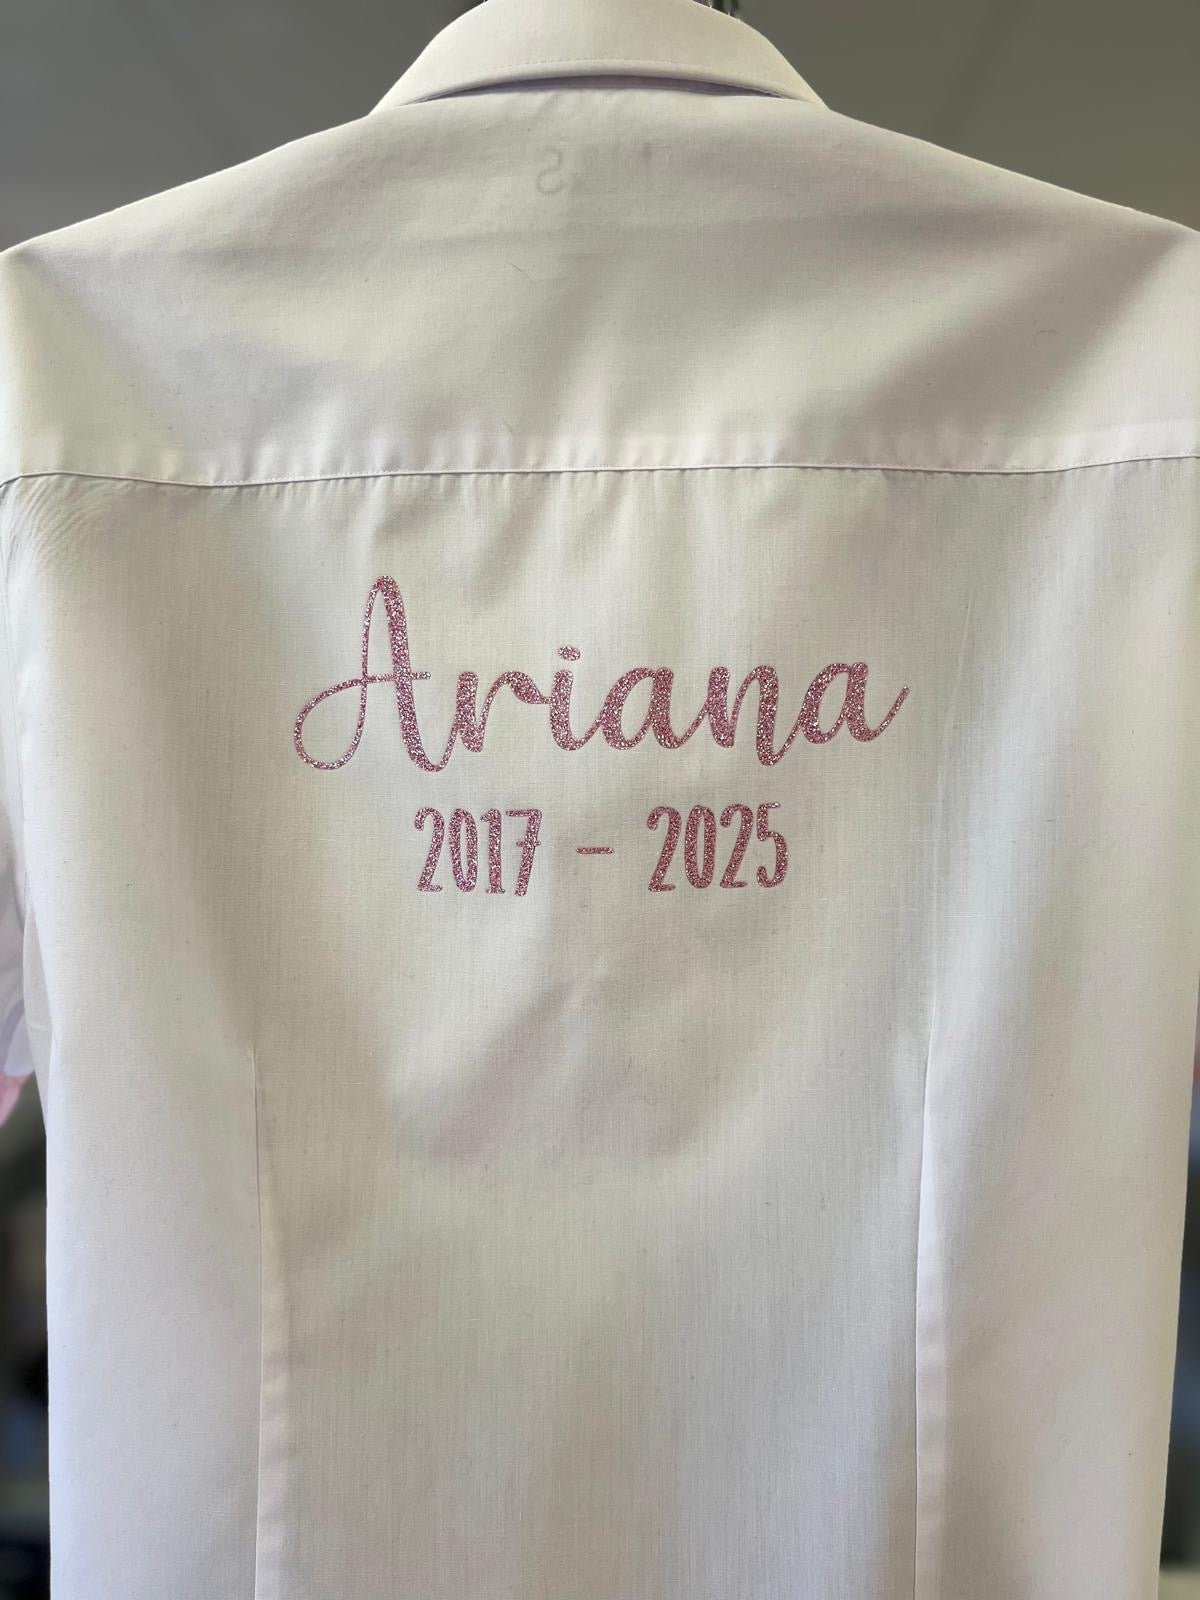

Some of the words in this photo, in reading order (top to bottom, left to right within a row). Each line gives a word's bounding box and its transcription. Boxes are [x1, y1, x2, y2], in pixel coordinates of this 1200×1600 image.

[294, 575, 909, 772] Ariana
[414, 807, 542, 897] 2017
[646, 802, 789, 892] 2025
